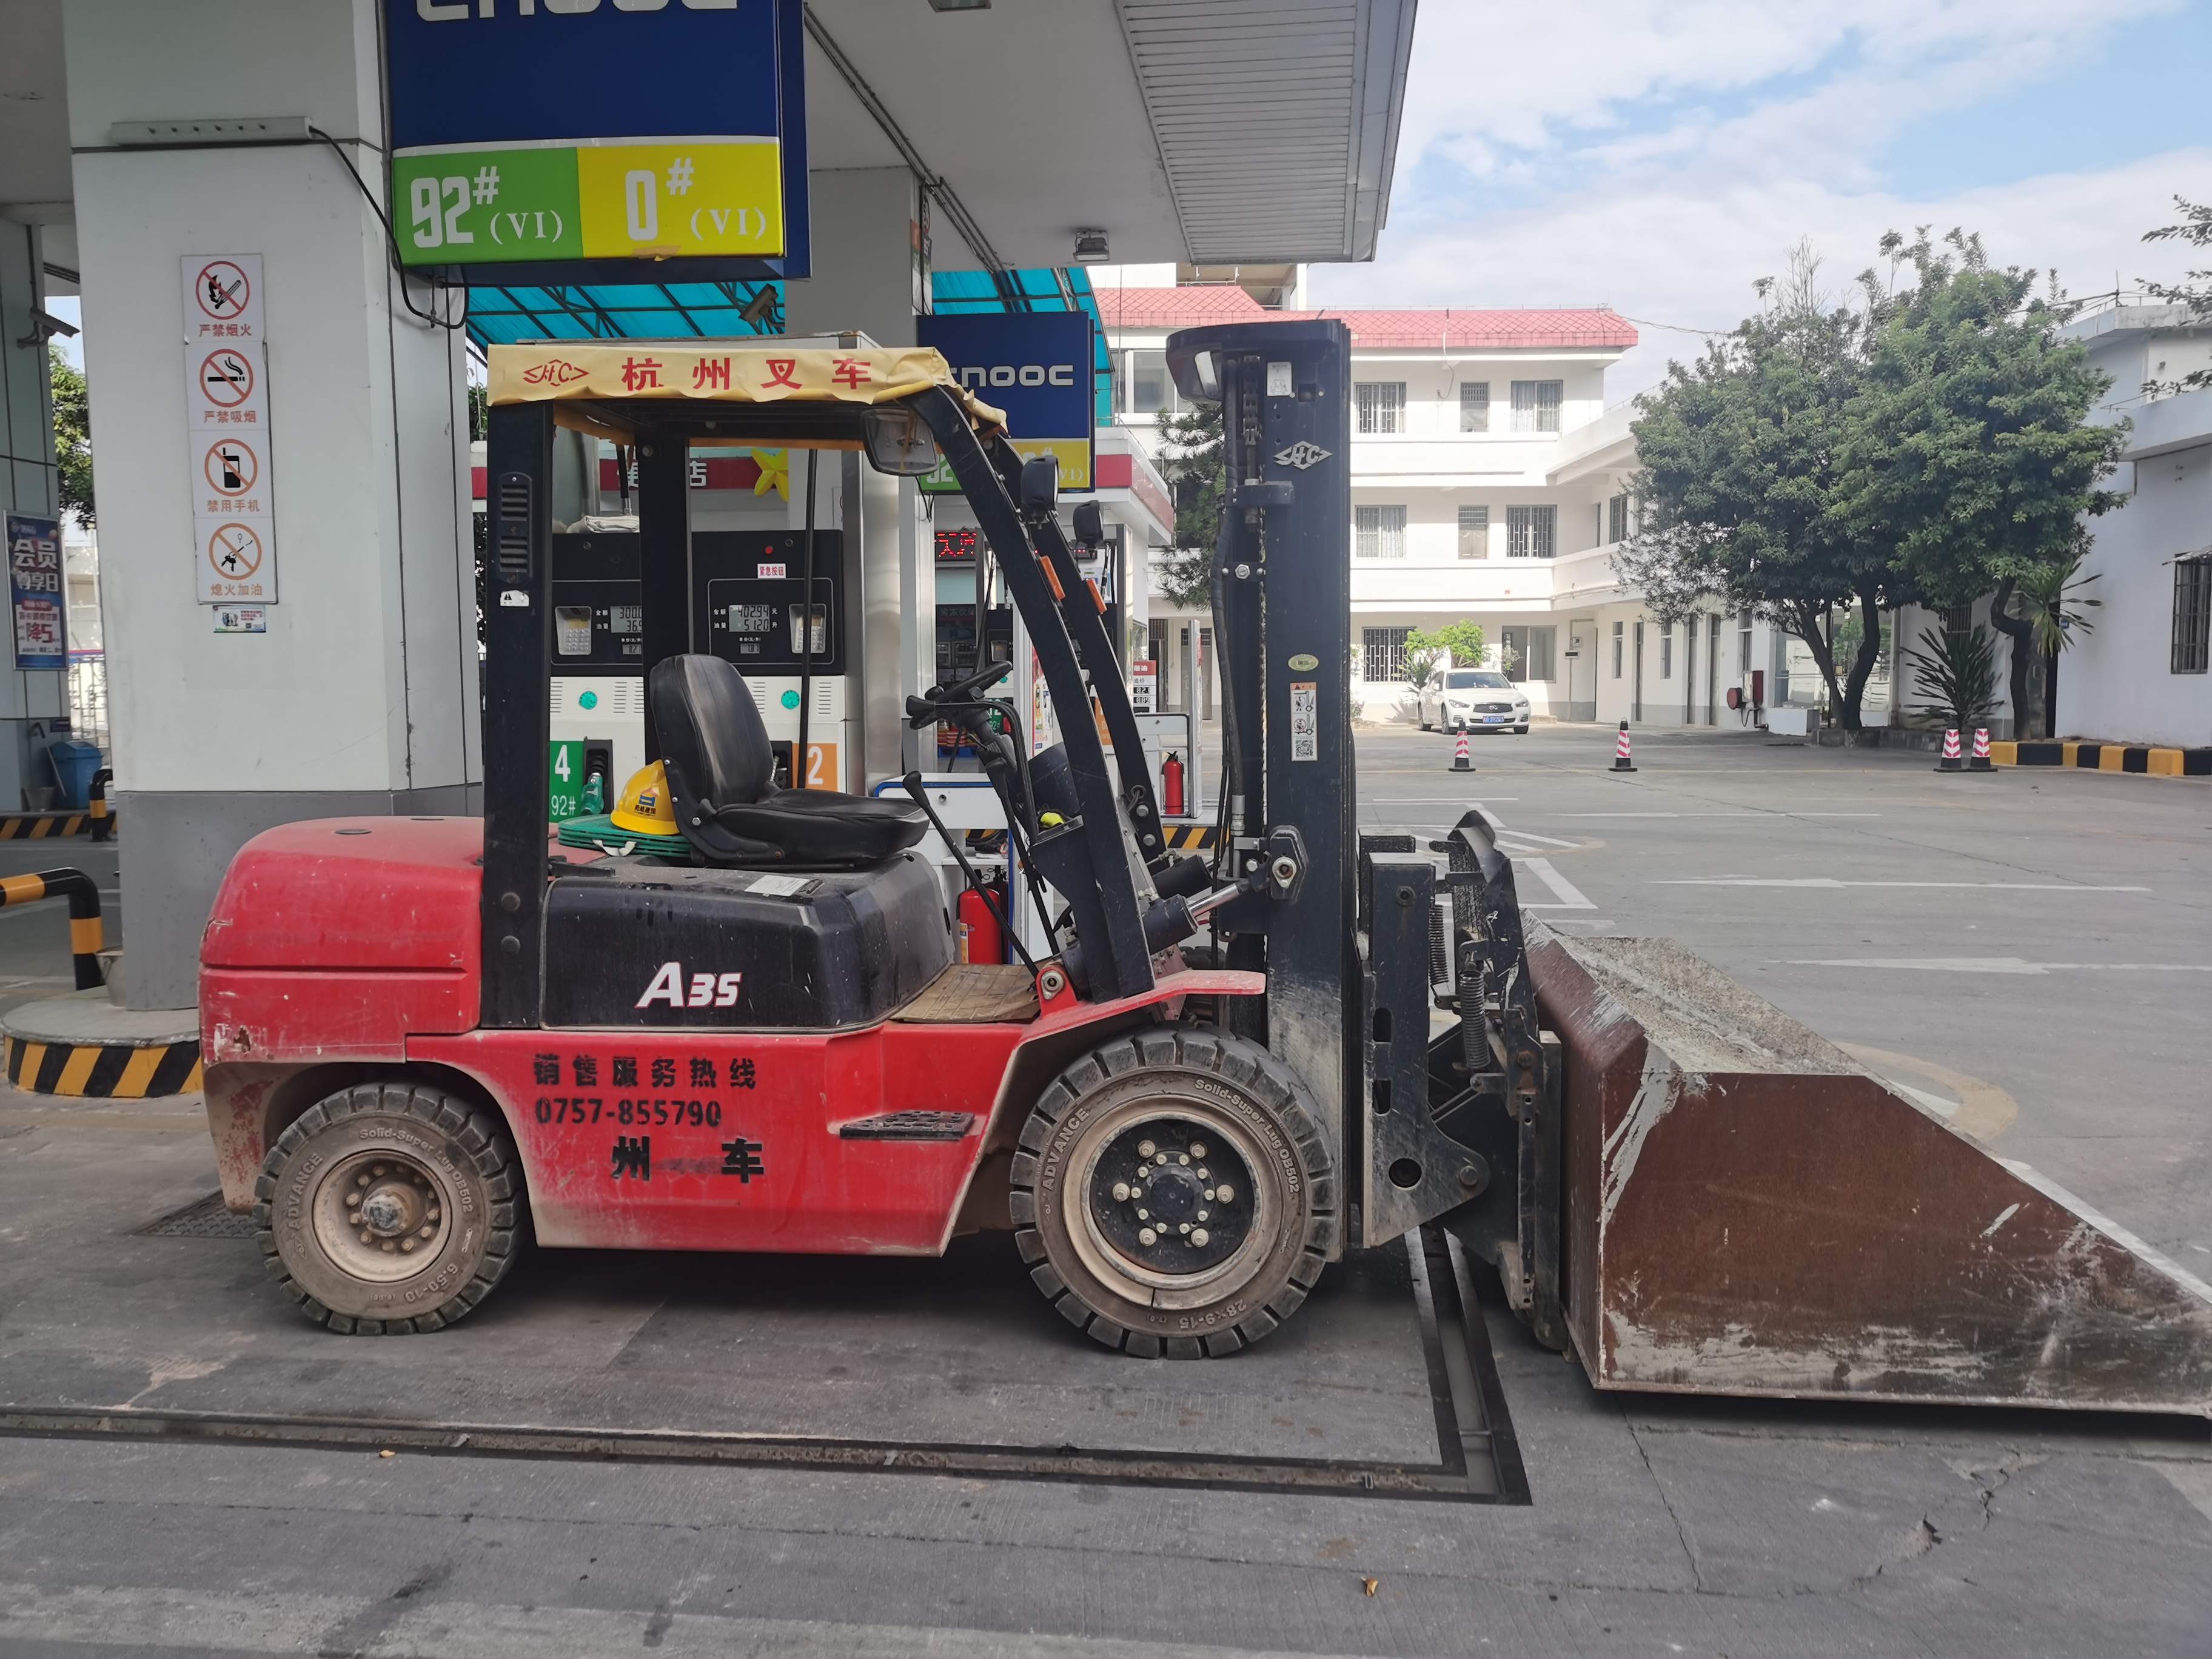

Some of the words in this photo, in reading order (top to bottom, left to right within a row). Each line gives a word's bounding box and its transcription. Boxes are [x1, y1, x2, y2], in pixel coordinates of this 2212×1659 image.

[625, 158, 694, 241] 0#
[690, 208, 766, 240] (VI)
[489, 212, 563, 244] (VI)
[199, 323, 252, 337] 严禁烟火
[622, 357, 871, 391] 杭州叉车
[951, 365, 1073, 387] nooc
[204, 411, 256, 424] 严禁吸烟
[207, 499, 260, 513] 禁用手机
[14, 538, 58, 569] 会员
[760, 566, 784, 576] 紧急按钮
[210, 583, 263, 597] 熄火加油
[554, 744, 571, 783] 4
[808, 746, 823, 785] 2
[551, 794, 576, 816] 92#
[634, 961, 743, 1009] A35
[534, 1054, 757, 1090] 销售服务热线
[535, 1097, 722, 1127] 0757-855790
[1042, 1107, 1090, 1191] ADVANCE
[1195, 1079, 1265, 1125] Solid-Super
[1262, 1124, 1283, 1150] Lug
[1279, 1148, 1300, 1194] OB502
[359, 1127, 435, 1152] Solid-Super
[453, 1170, 473, 1213] OB502
[287, 1153, 323, 1230] ADVANCE
[404, 1262, 458, 1302] 6.50-10
